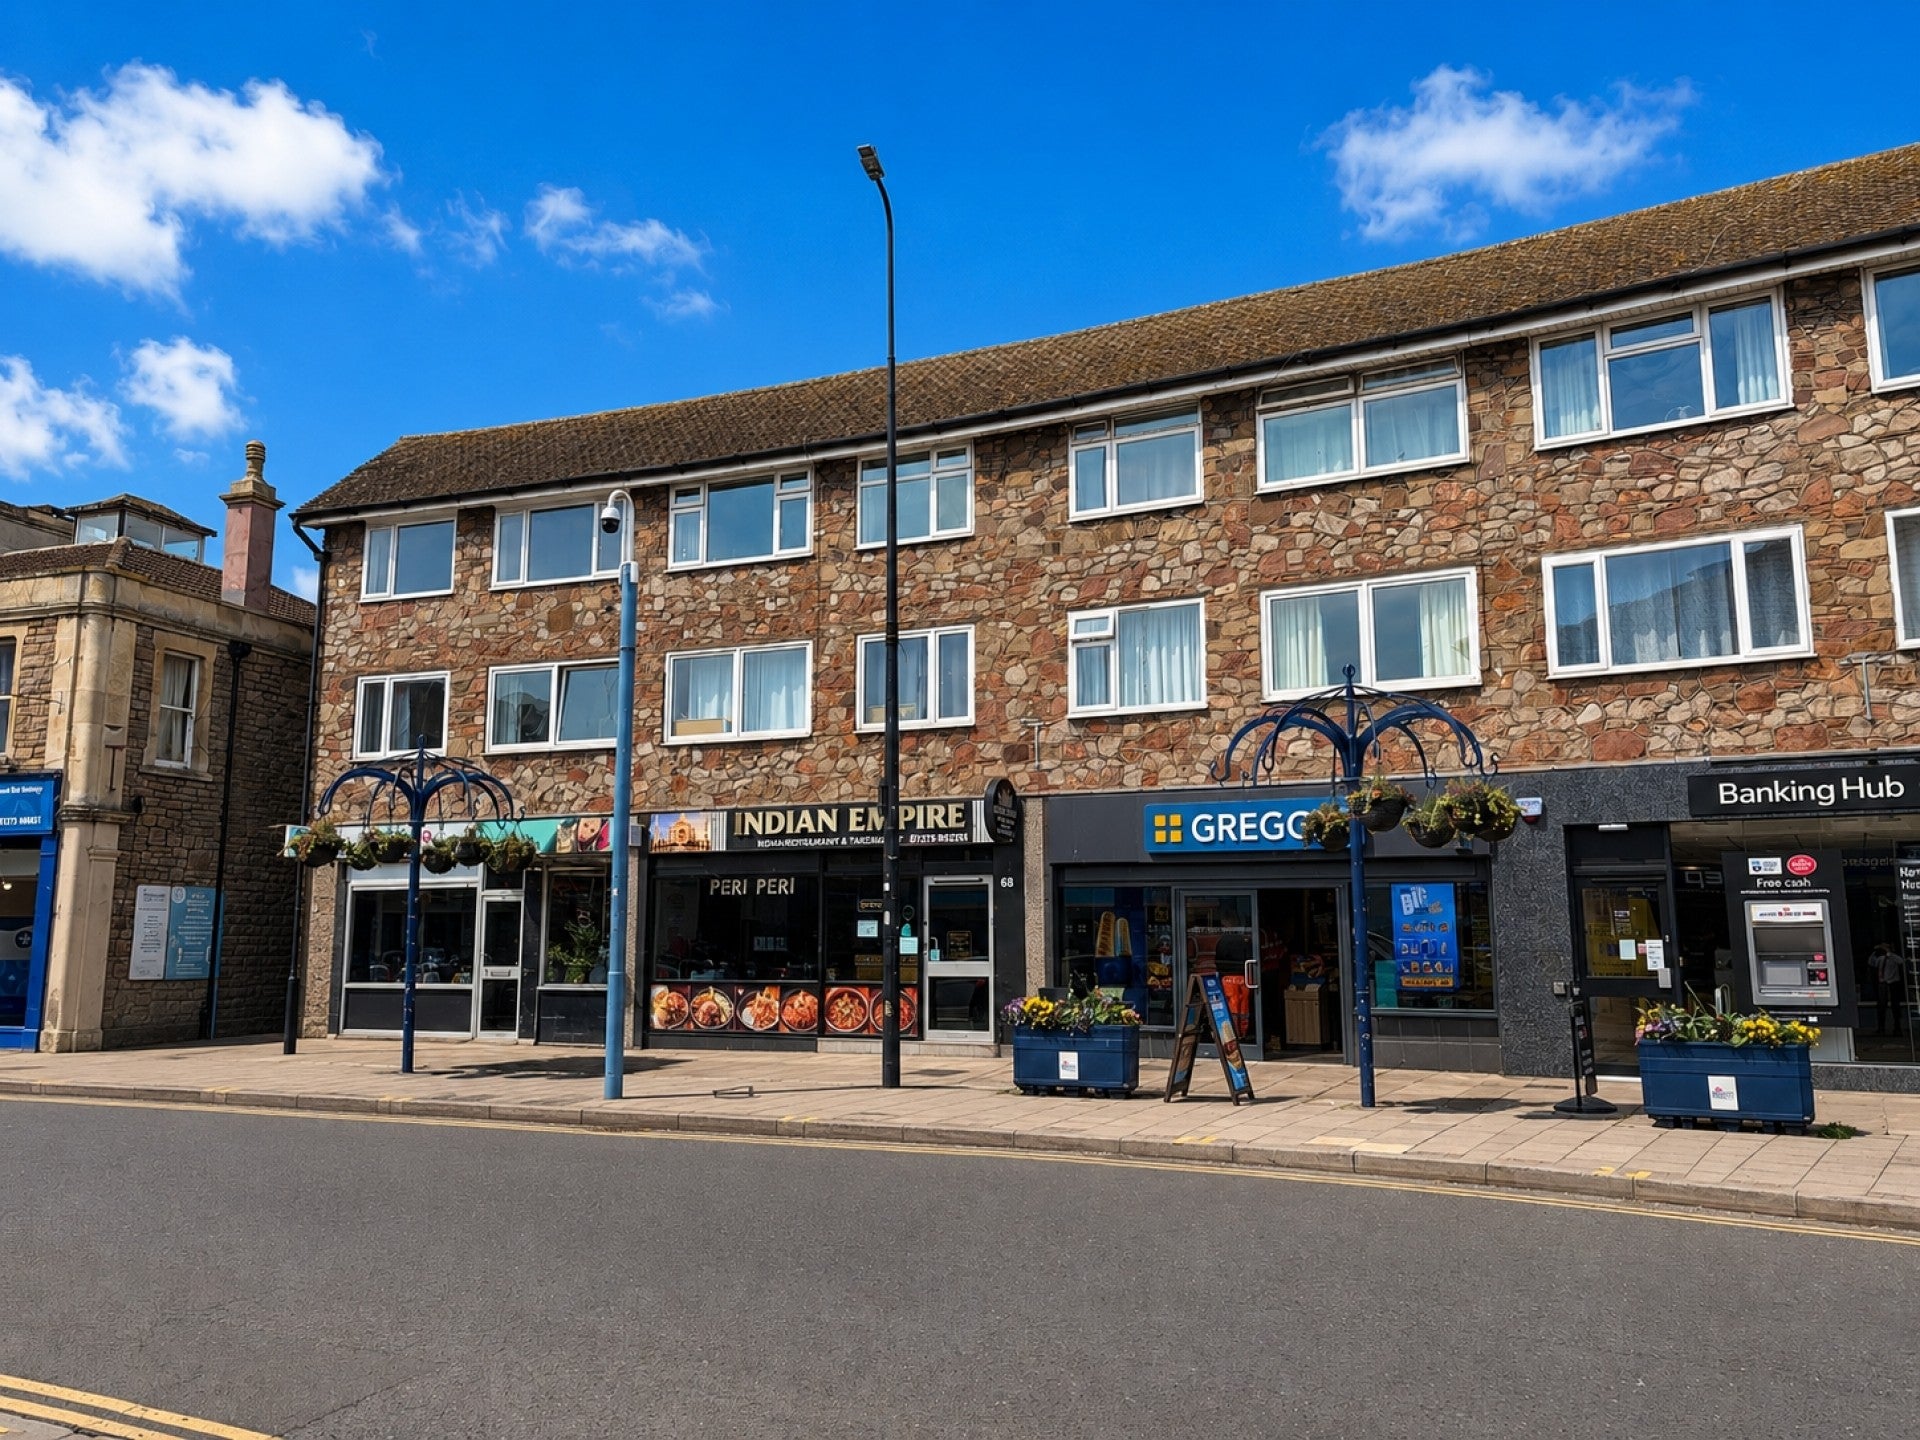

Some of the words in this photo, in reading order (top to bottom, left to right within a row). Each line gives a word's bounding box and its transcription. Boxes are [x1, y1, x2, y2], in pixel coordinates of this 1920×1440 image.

[1718, 780, 1835, 806] Banking
[1841, 774, 1905, 800] Hub
[734, 808, 839, 836] INDIAN
[1191, 810, 1313, 843] GREGG
[710, 878, 748, 896] PERI
[756, 877, 795, 895] PERI
[1000, 877, 1014, 888] 68
